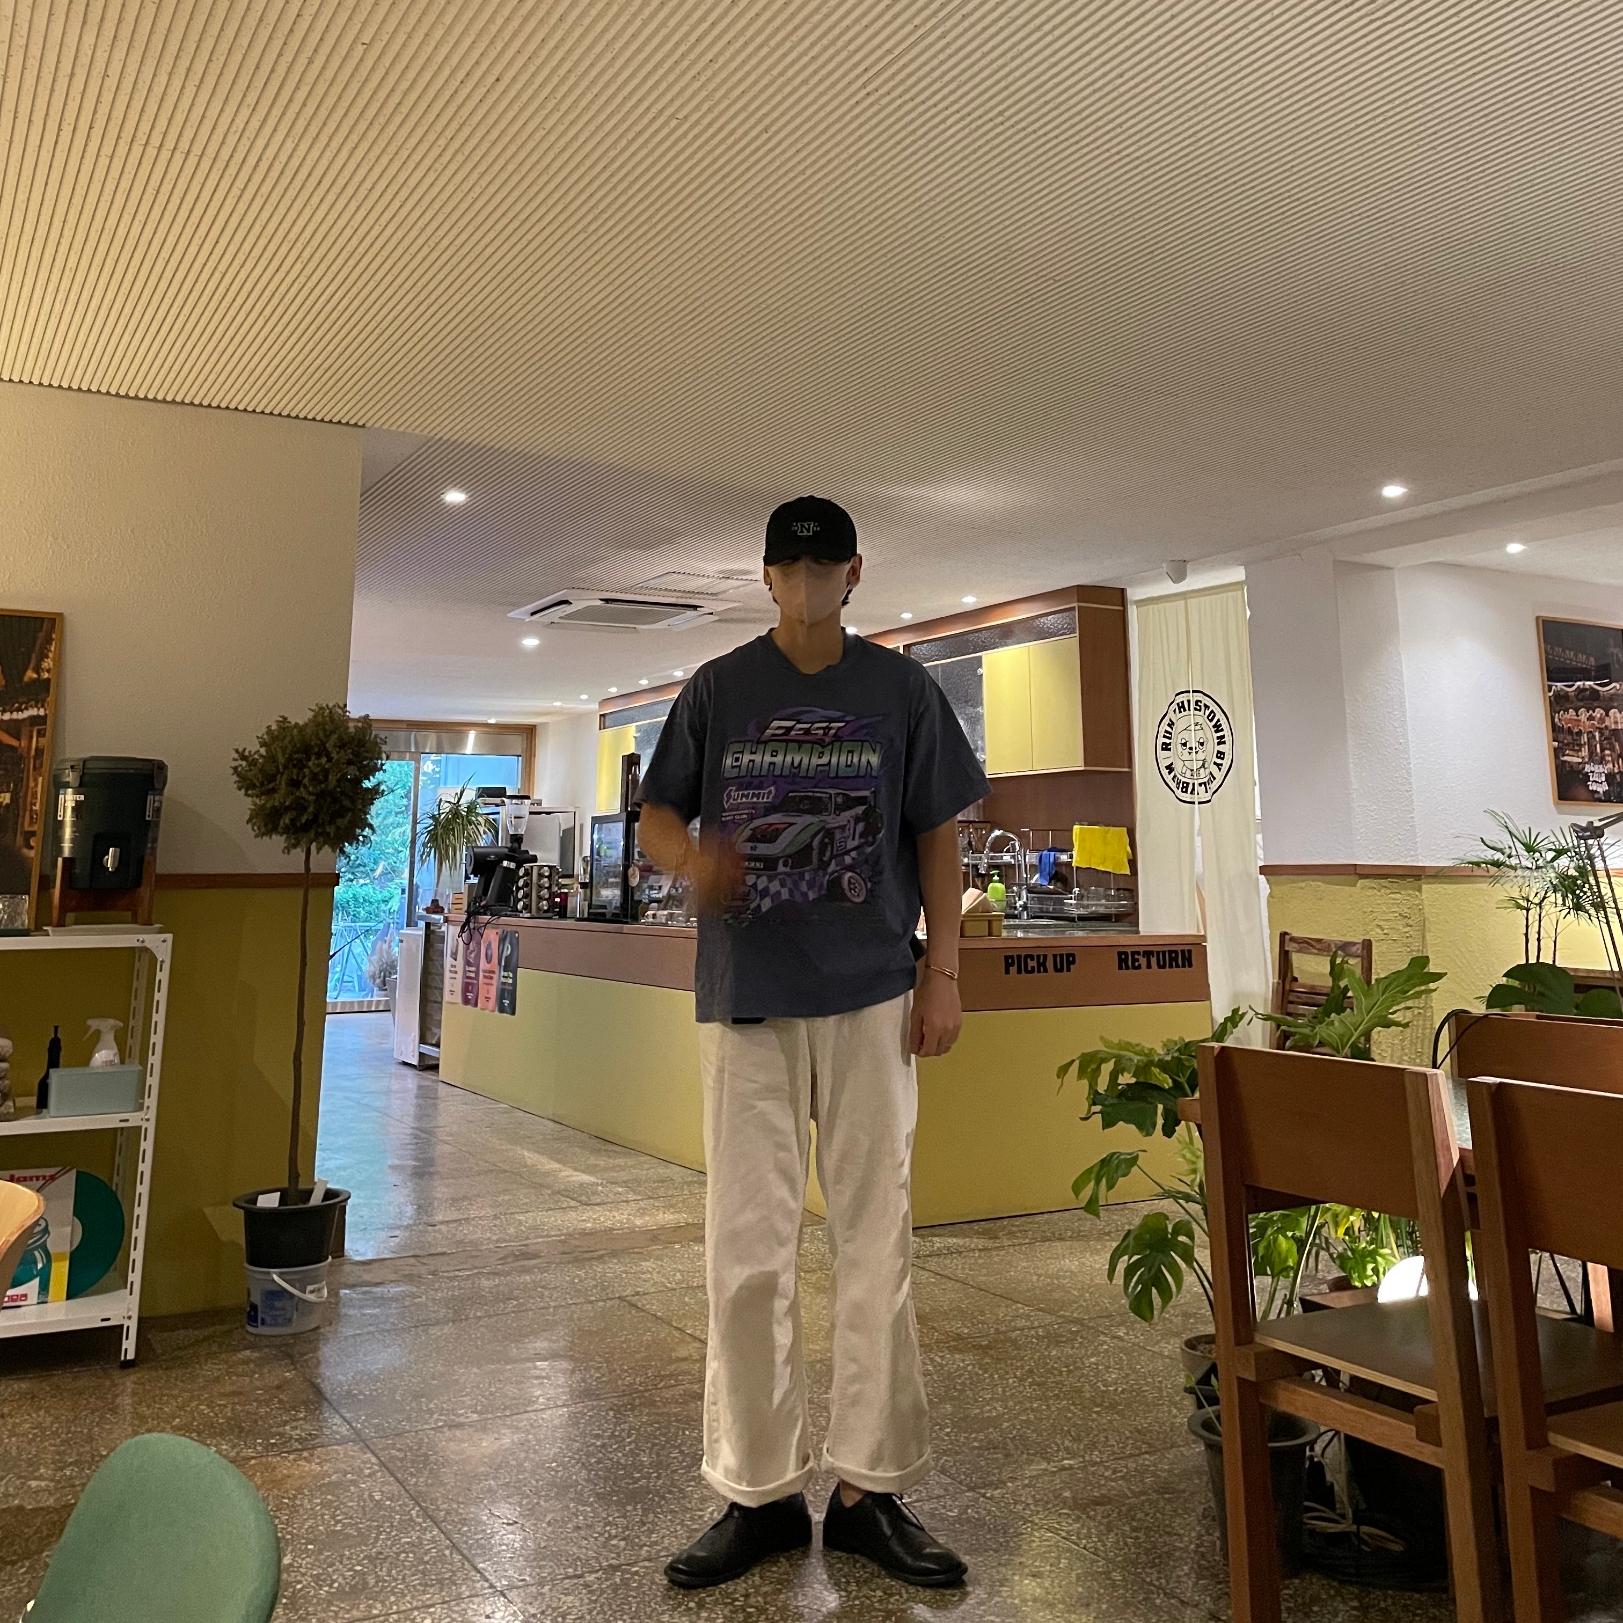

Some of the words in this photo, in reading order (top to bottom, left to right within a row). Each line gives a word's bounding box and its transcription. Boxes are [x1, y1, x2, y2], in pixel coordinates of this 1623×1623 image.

[722, 739, 884, 779] CHAMPION
[1161, 718, 1175, 752] RUN
[1212, 750, 1226, 772] BY
[1004, 953, 1048, 975] PICK
[1053, 952, 1077, 973] UP
[1117, 949, 1194, 971] RETURN
